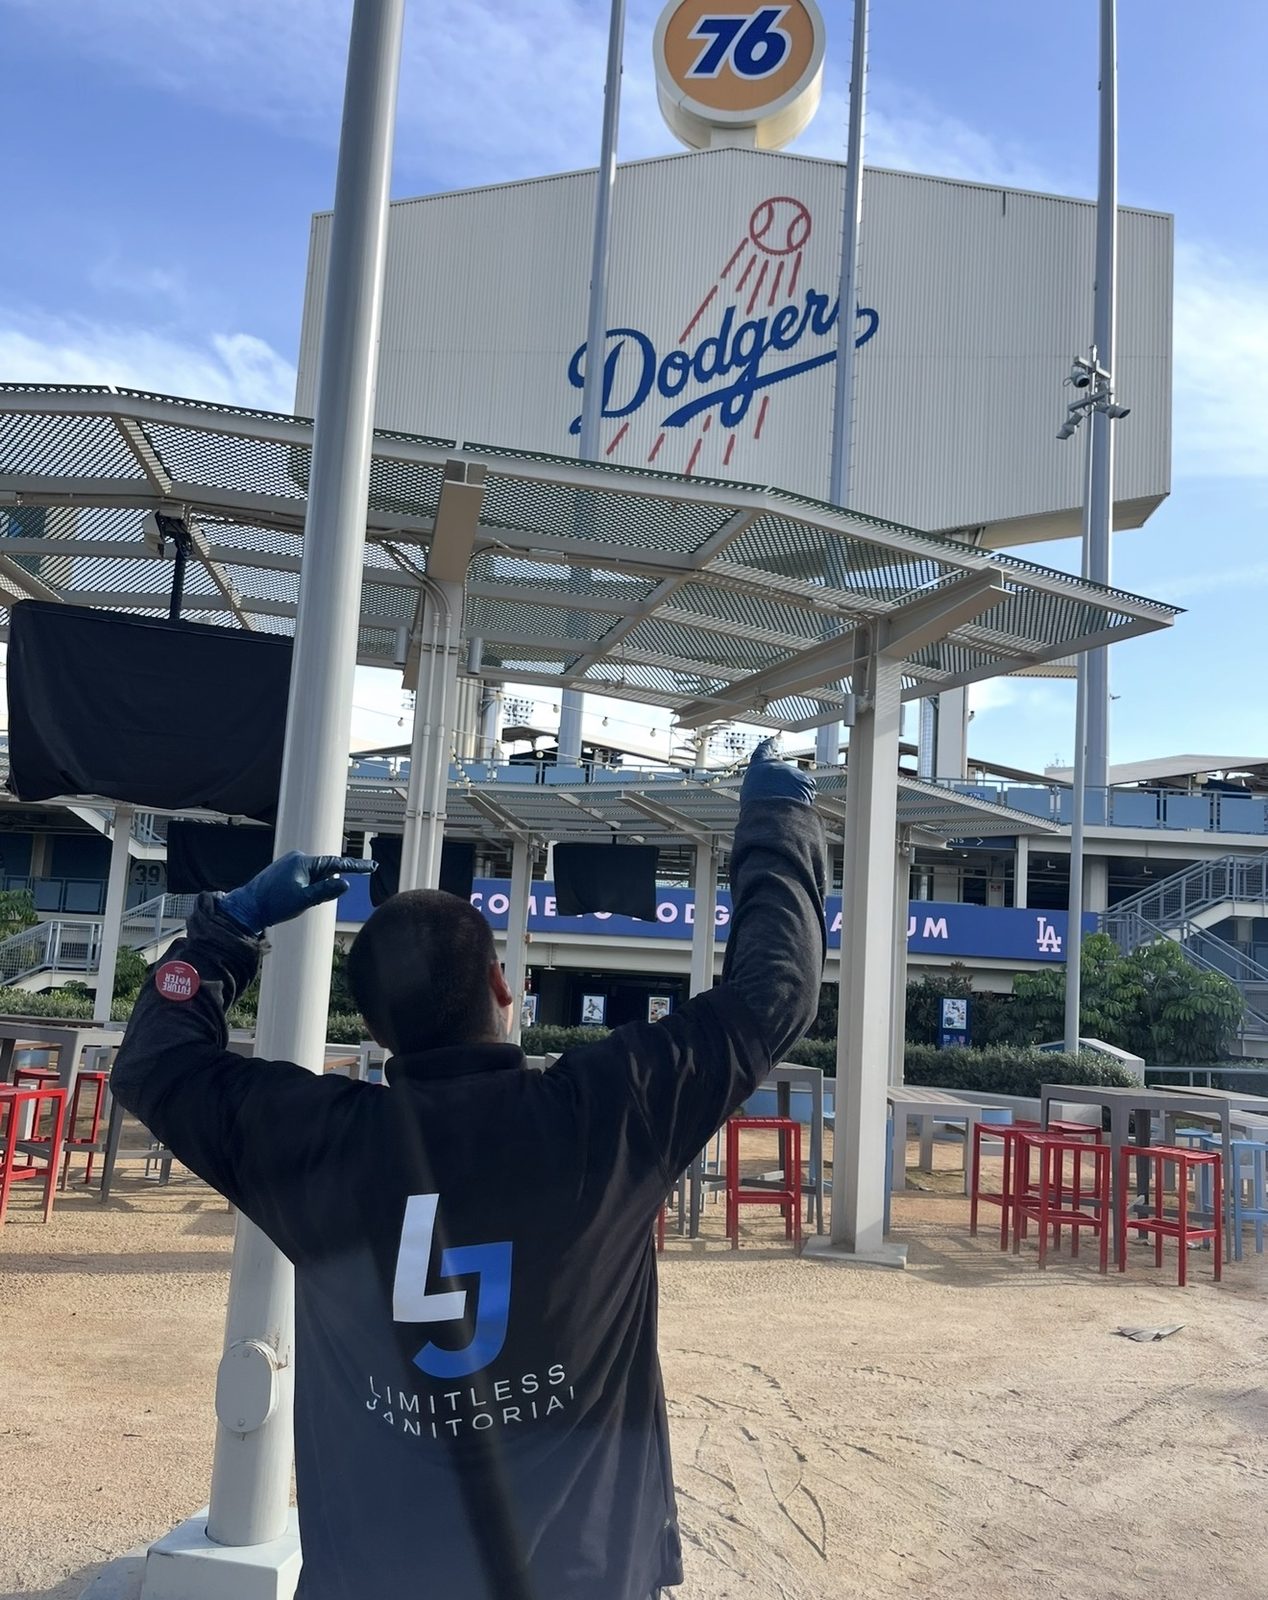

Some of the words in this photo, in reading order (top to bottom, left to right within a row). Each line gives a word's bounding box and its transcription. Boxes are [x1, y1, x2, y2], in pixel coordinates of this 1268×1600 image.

[685, 6, 792, 80] 76
[1037, 917, 1062, 953] LA
[162, 981, 191, 996] FUTURE
[369, 1364, 566, 1414] LIMITLESS
